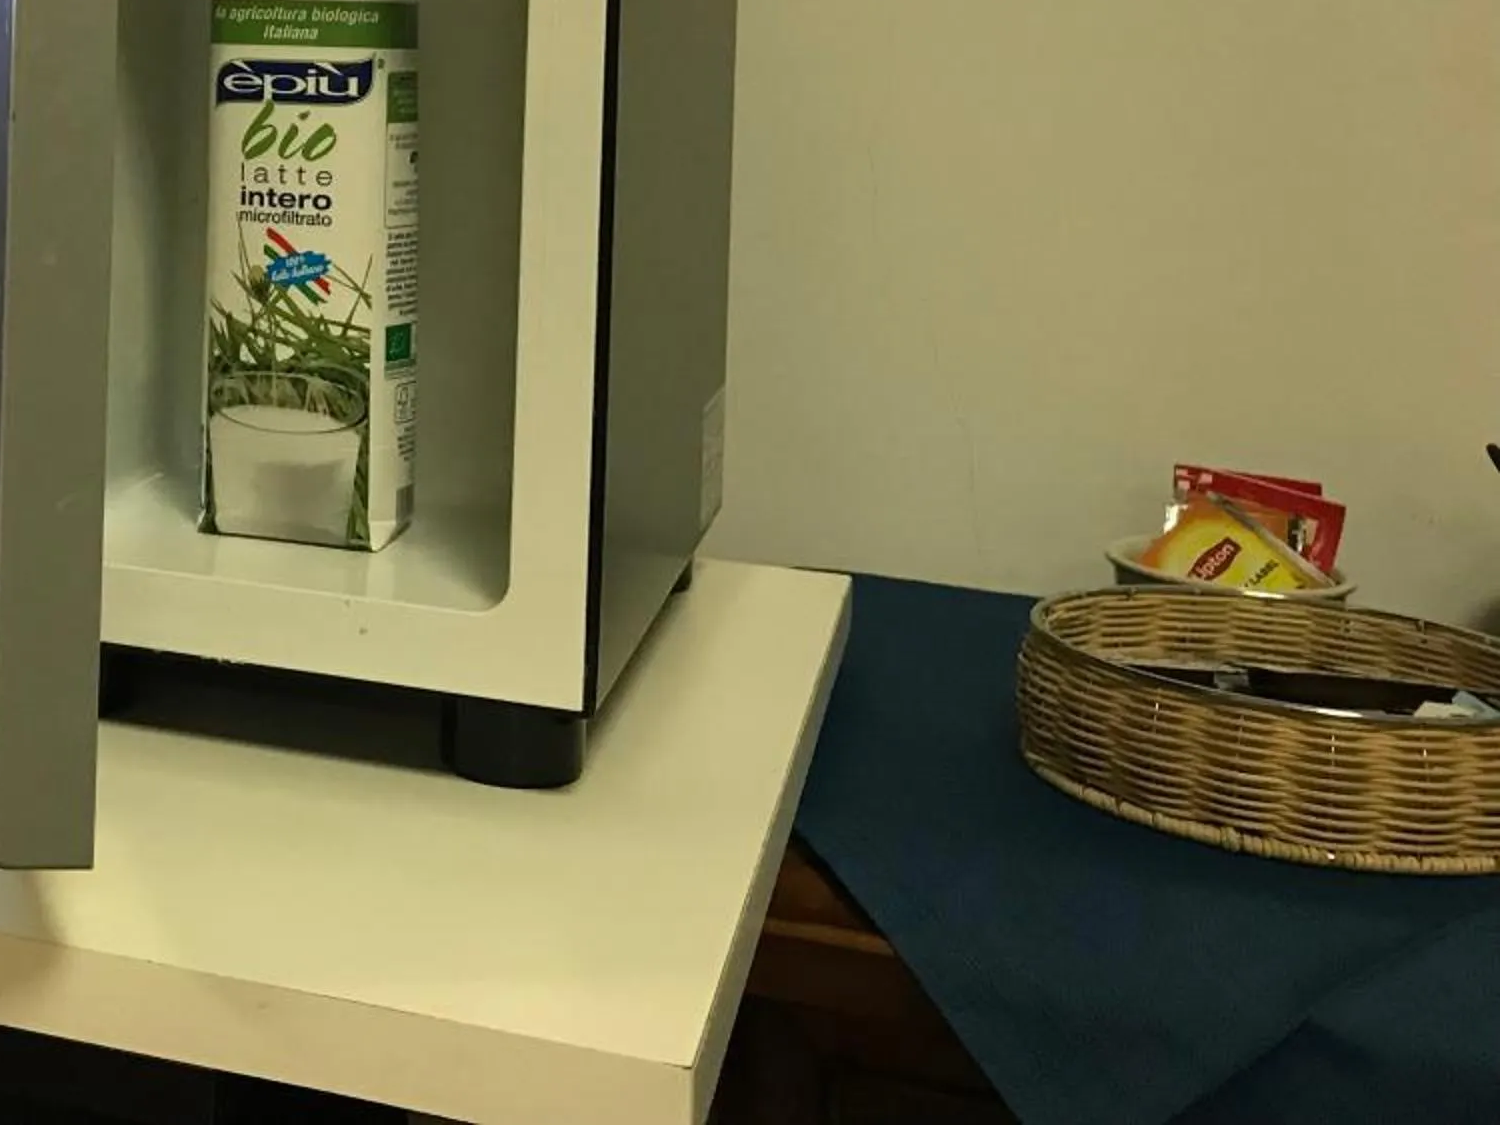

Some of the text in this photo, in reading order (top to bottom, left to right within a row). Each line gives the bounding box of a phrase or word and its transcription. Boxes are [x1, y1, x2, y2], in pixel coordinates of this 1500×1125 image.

[229, 5, 307, 23] agricoltura
[311, 6, 379, 26] biologica
[241, 99, 337, 162] bio
[240, 163, 333, 187] latte
[240, 186, 333, 212] intero
[239, 210, 333, 228] microfiltrato
[1195, 543, 1235, 578] ipton
